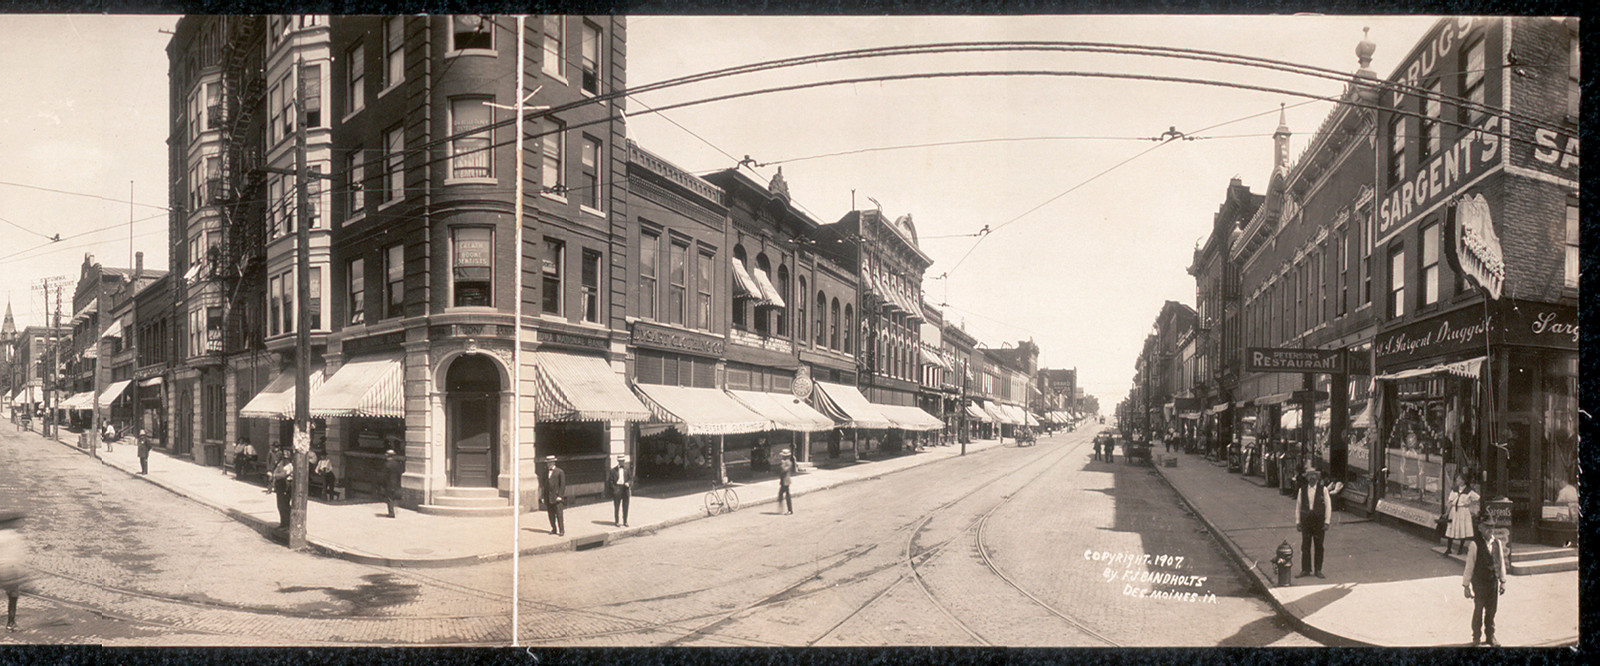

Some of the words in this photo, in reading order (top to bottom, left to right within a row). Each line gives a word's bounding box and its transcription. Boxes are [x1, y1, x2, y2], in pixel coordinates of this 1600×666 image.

[1380, 114, 1500, 234] SARGENT'S
[671, 335, 711, 352] CLOTHING
[1253, 351, 1338, 369] RESTAURANT
